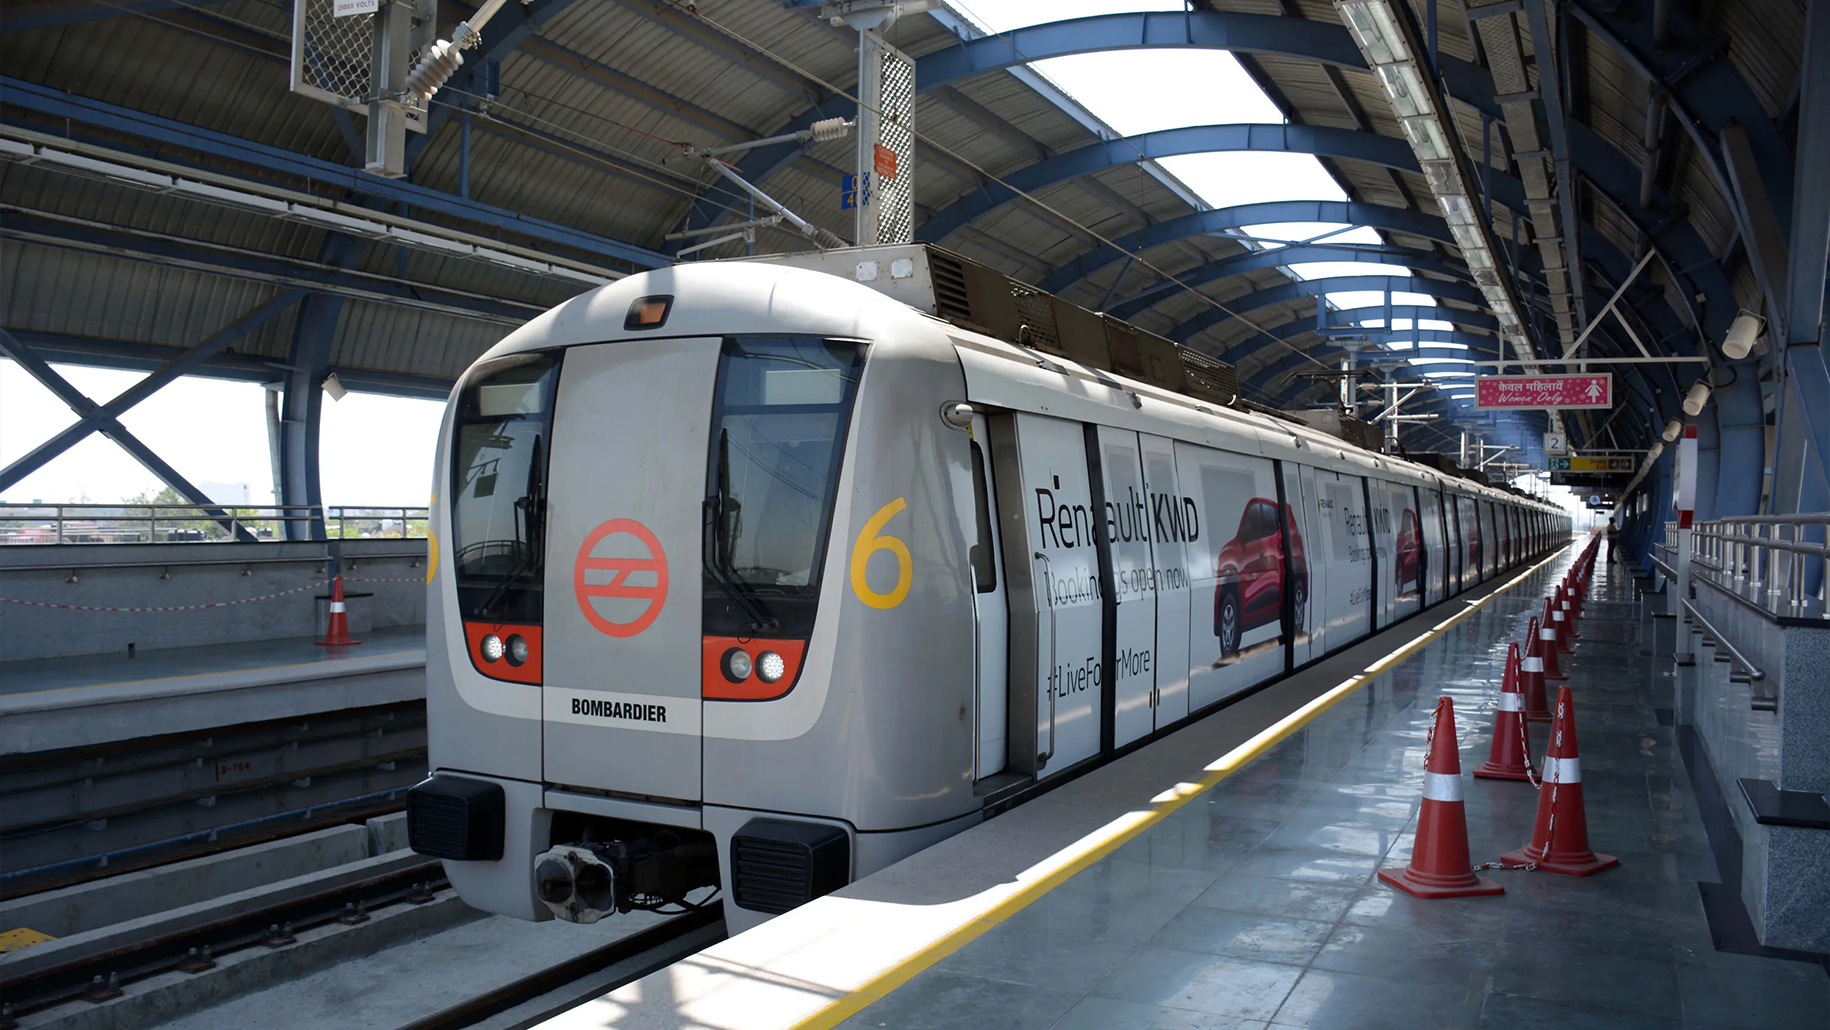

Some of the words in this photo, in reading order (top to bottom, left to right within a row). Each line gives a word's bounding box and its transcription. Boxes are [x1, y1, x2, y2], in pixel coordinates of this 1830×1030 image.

[338, 3, 353, 11] 25000
[1498, 380, 1523, 392] केवल
[1498, 392, 1532, 403] Women
[1537, 392, 1564, 405] Only
[1551, 438, 1559, 449] 2
[850, 496, 913, 610] 6
[1131, 568, 1164, 601] open
[1166, 567, 1190, 590] now
[571, 697, 667, 723] BOMBARDIER
